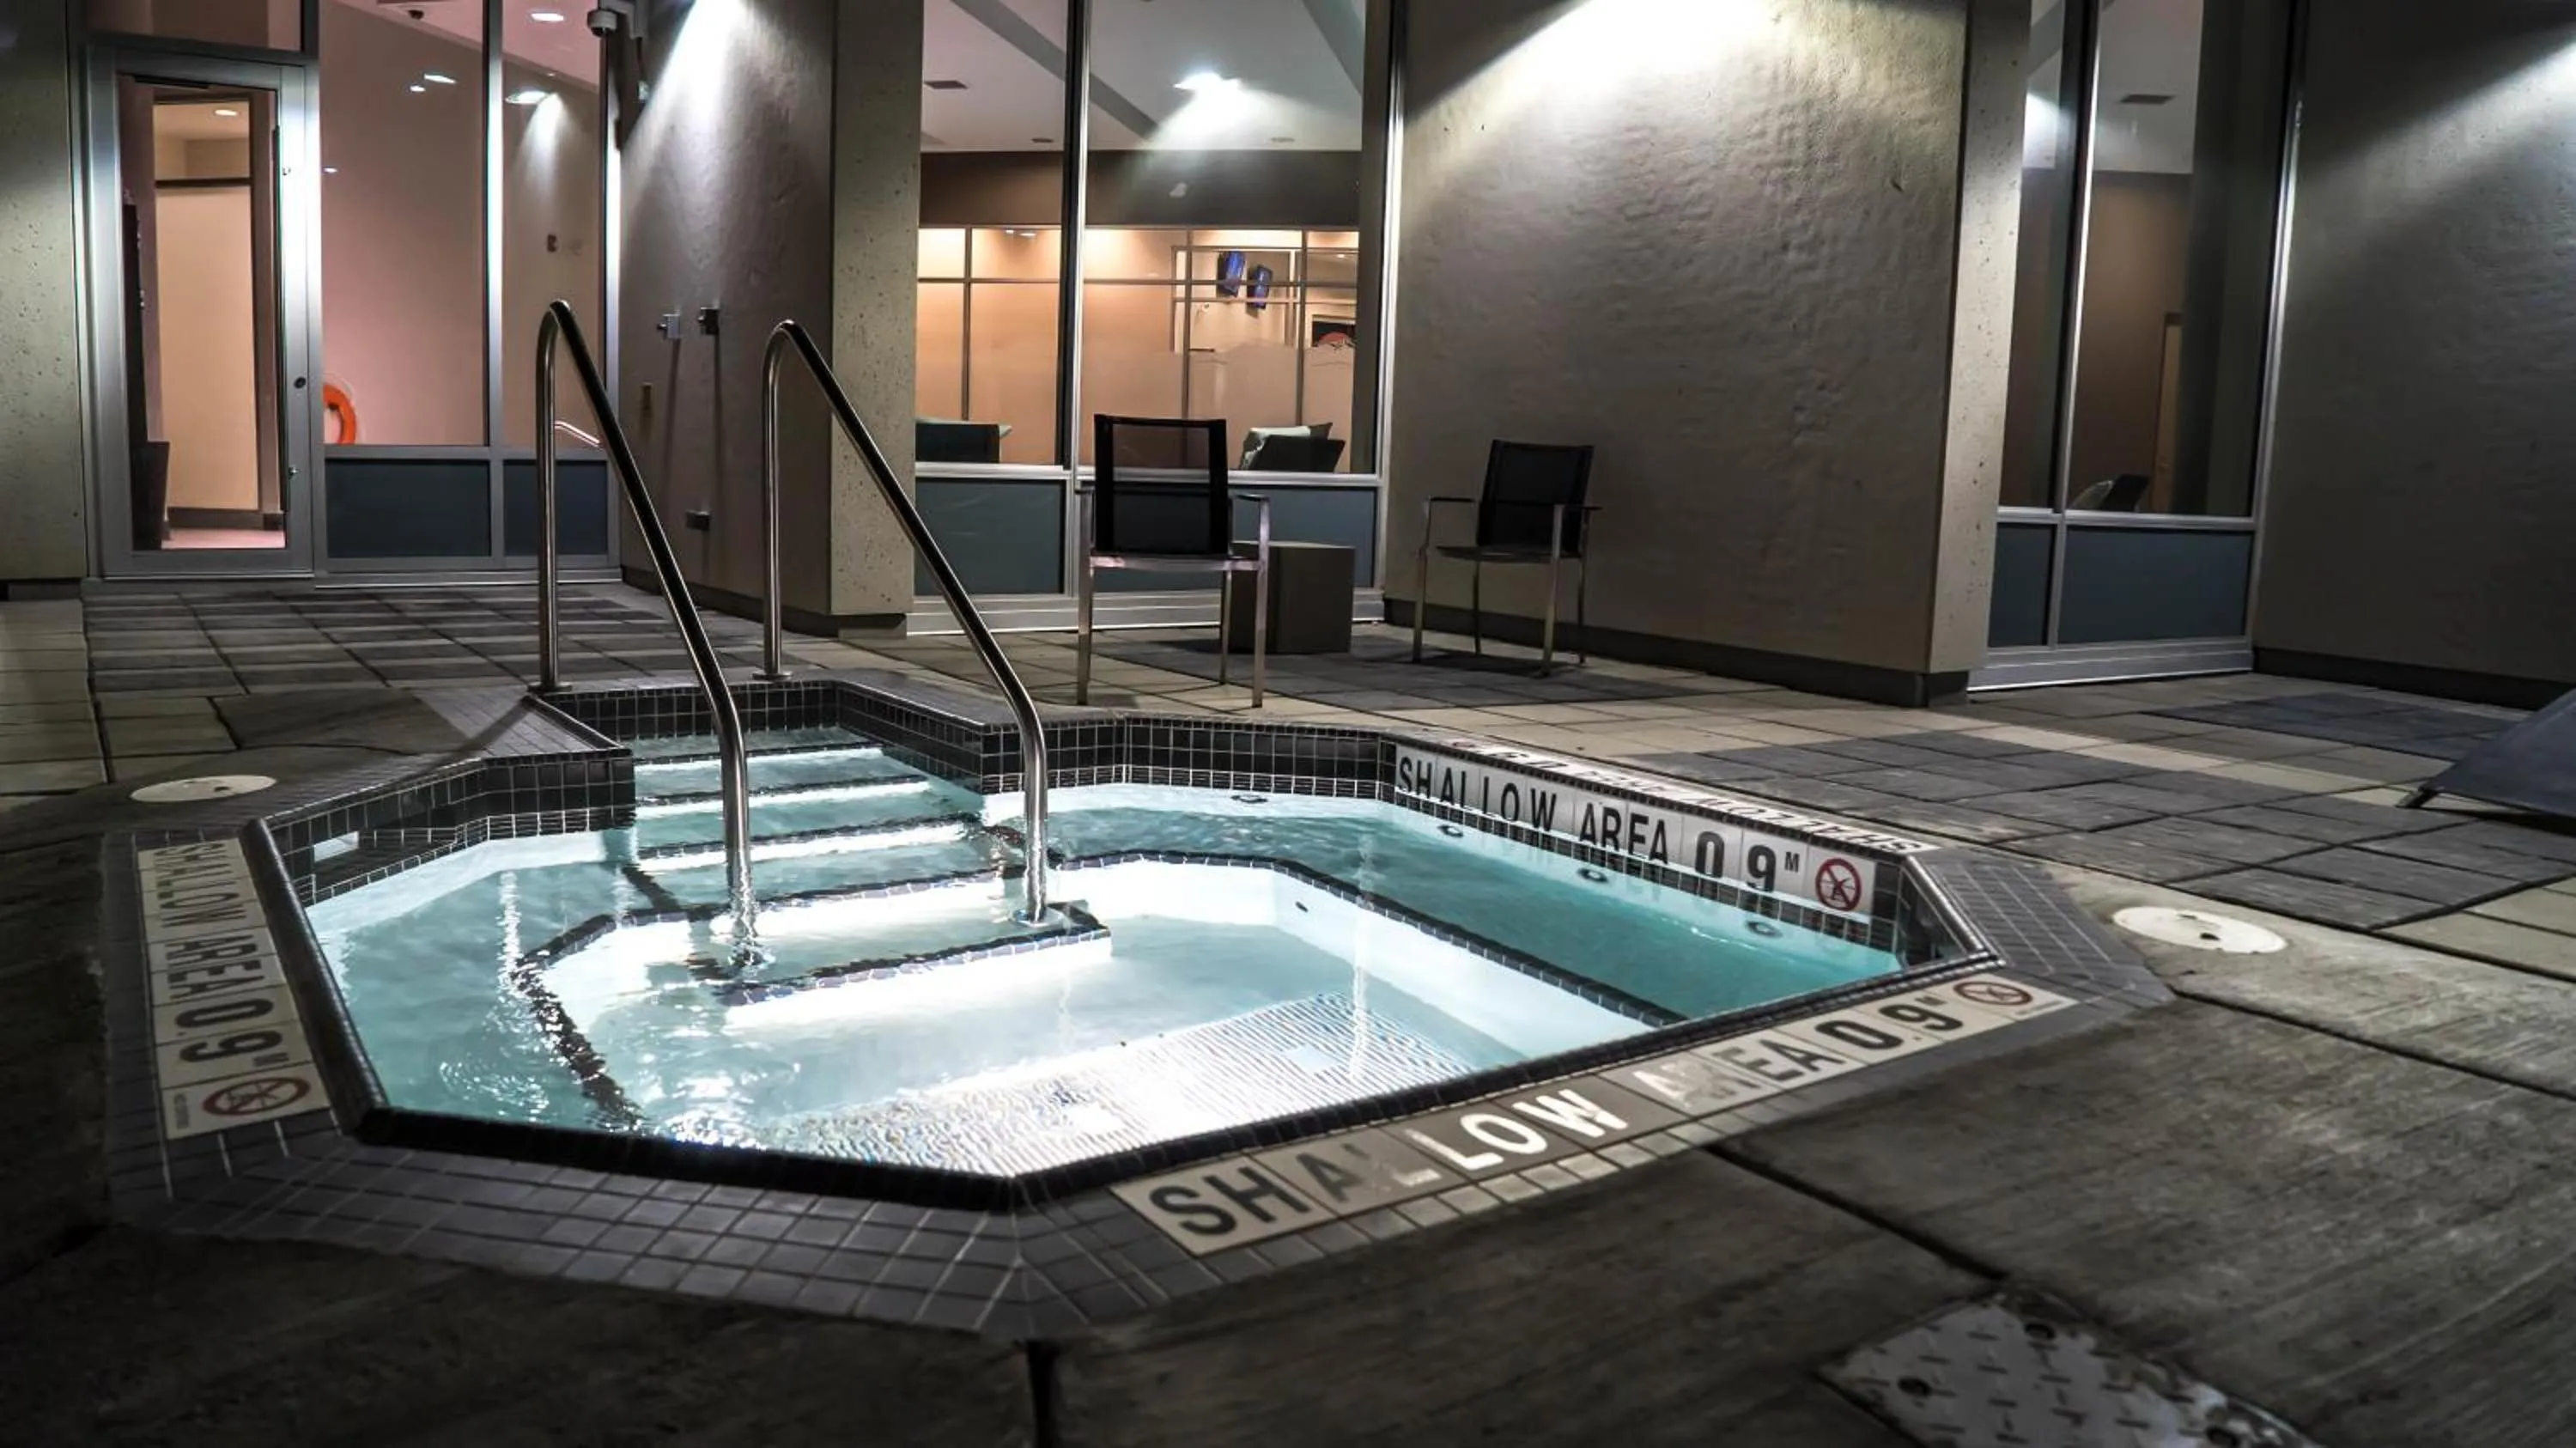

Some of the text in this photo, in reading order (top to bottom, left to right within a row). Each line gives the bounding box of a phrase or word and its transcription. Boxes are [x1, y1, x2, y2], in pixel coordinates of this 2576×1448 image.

[1399, 756, 1557, 831] SHALLOW
[1579, 801, 1668, 864] AREA
[165, 934, 265, 1000] AREA
